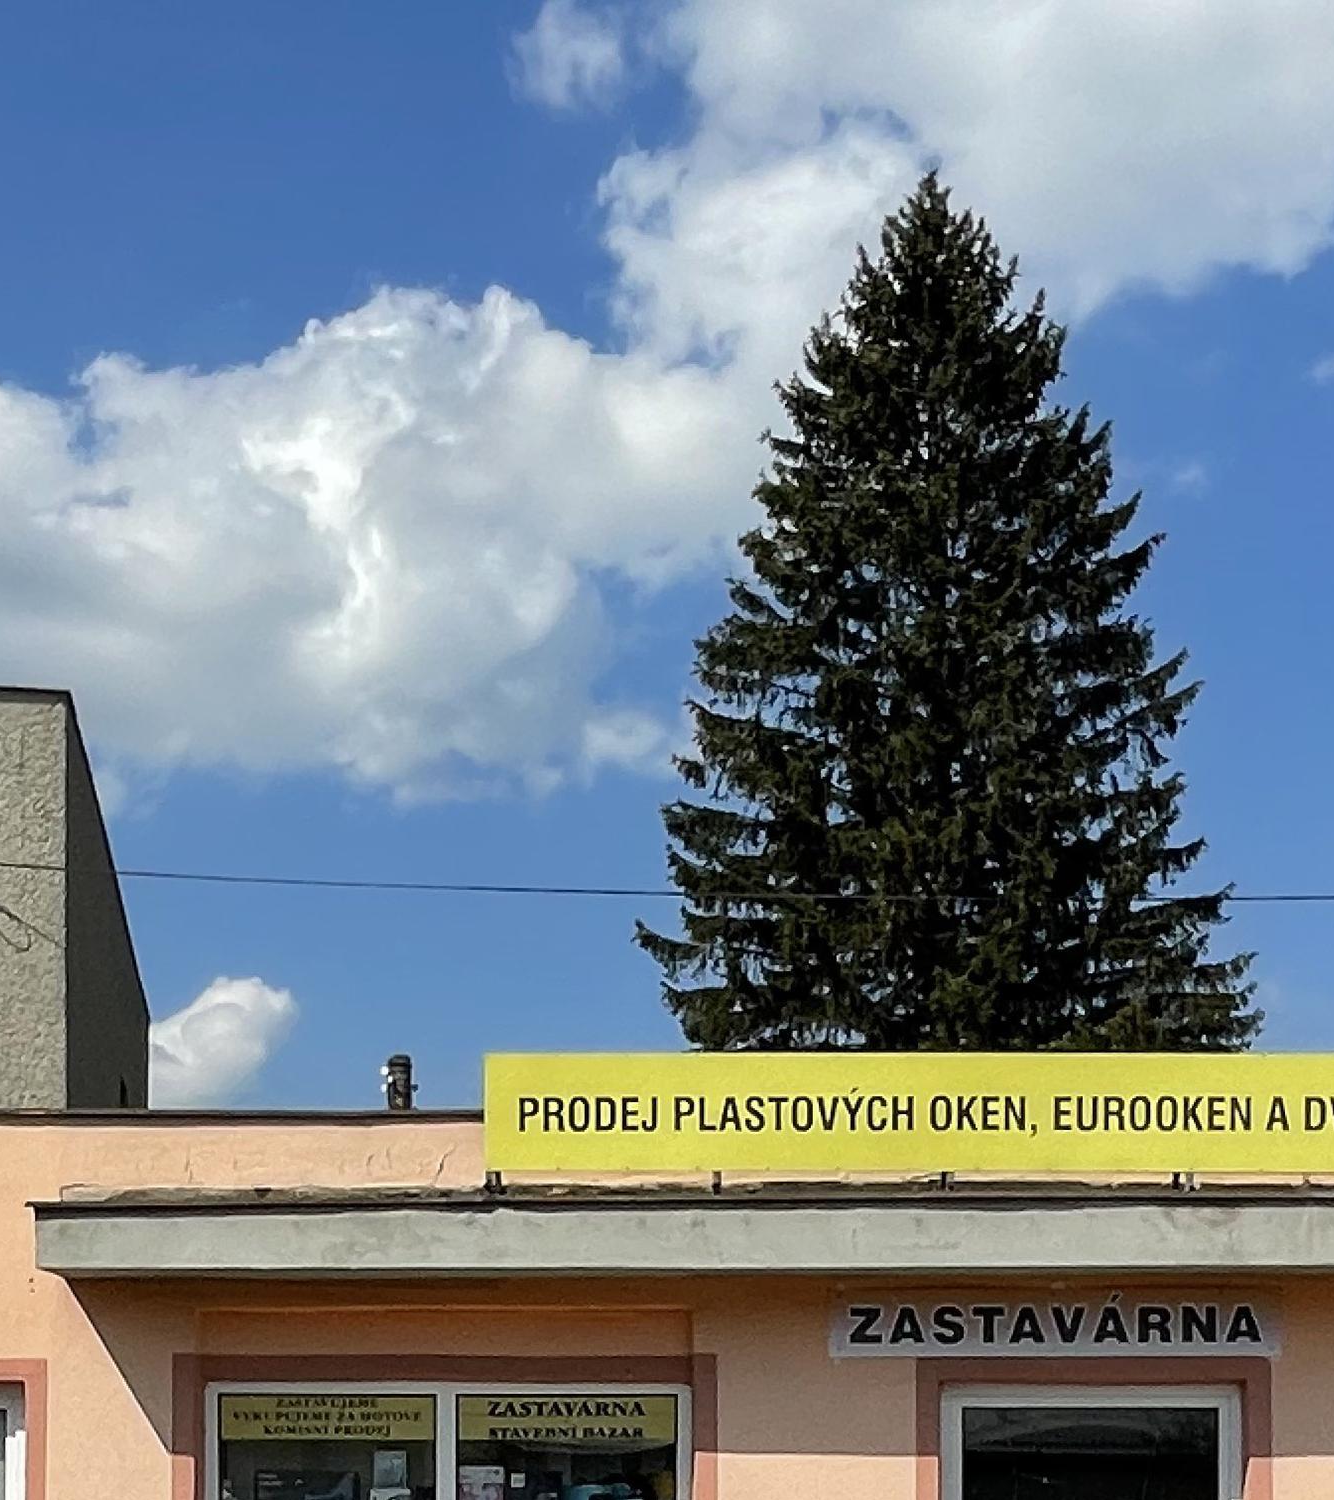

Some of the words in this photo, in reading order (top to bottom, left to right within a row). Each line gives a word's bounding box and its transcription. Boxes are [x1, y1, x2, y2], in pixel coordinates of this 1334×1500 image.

[517, 1096, 658, 1133] PRODEJ
[673, 1087, 915, 1133] PLASTOVÝCH
[929, 1095, 1038, 1136] OKEN,
[1054, 1095, 1252, 1132] EUROOKEN
[1266, 1096, 1290, 1132] A
[848, 1294, 1263, 1345] ZASTAVÁRNA
